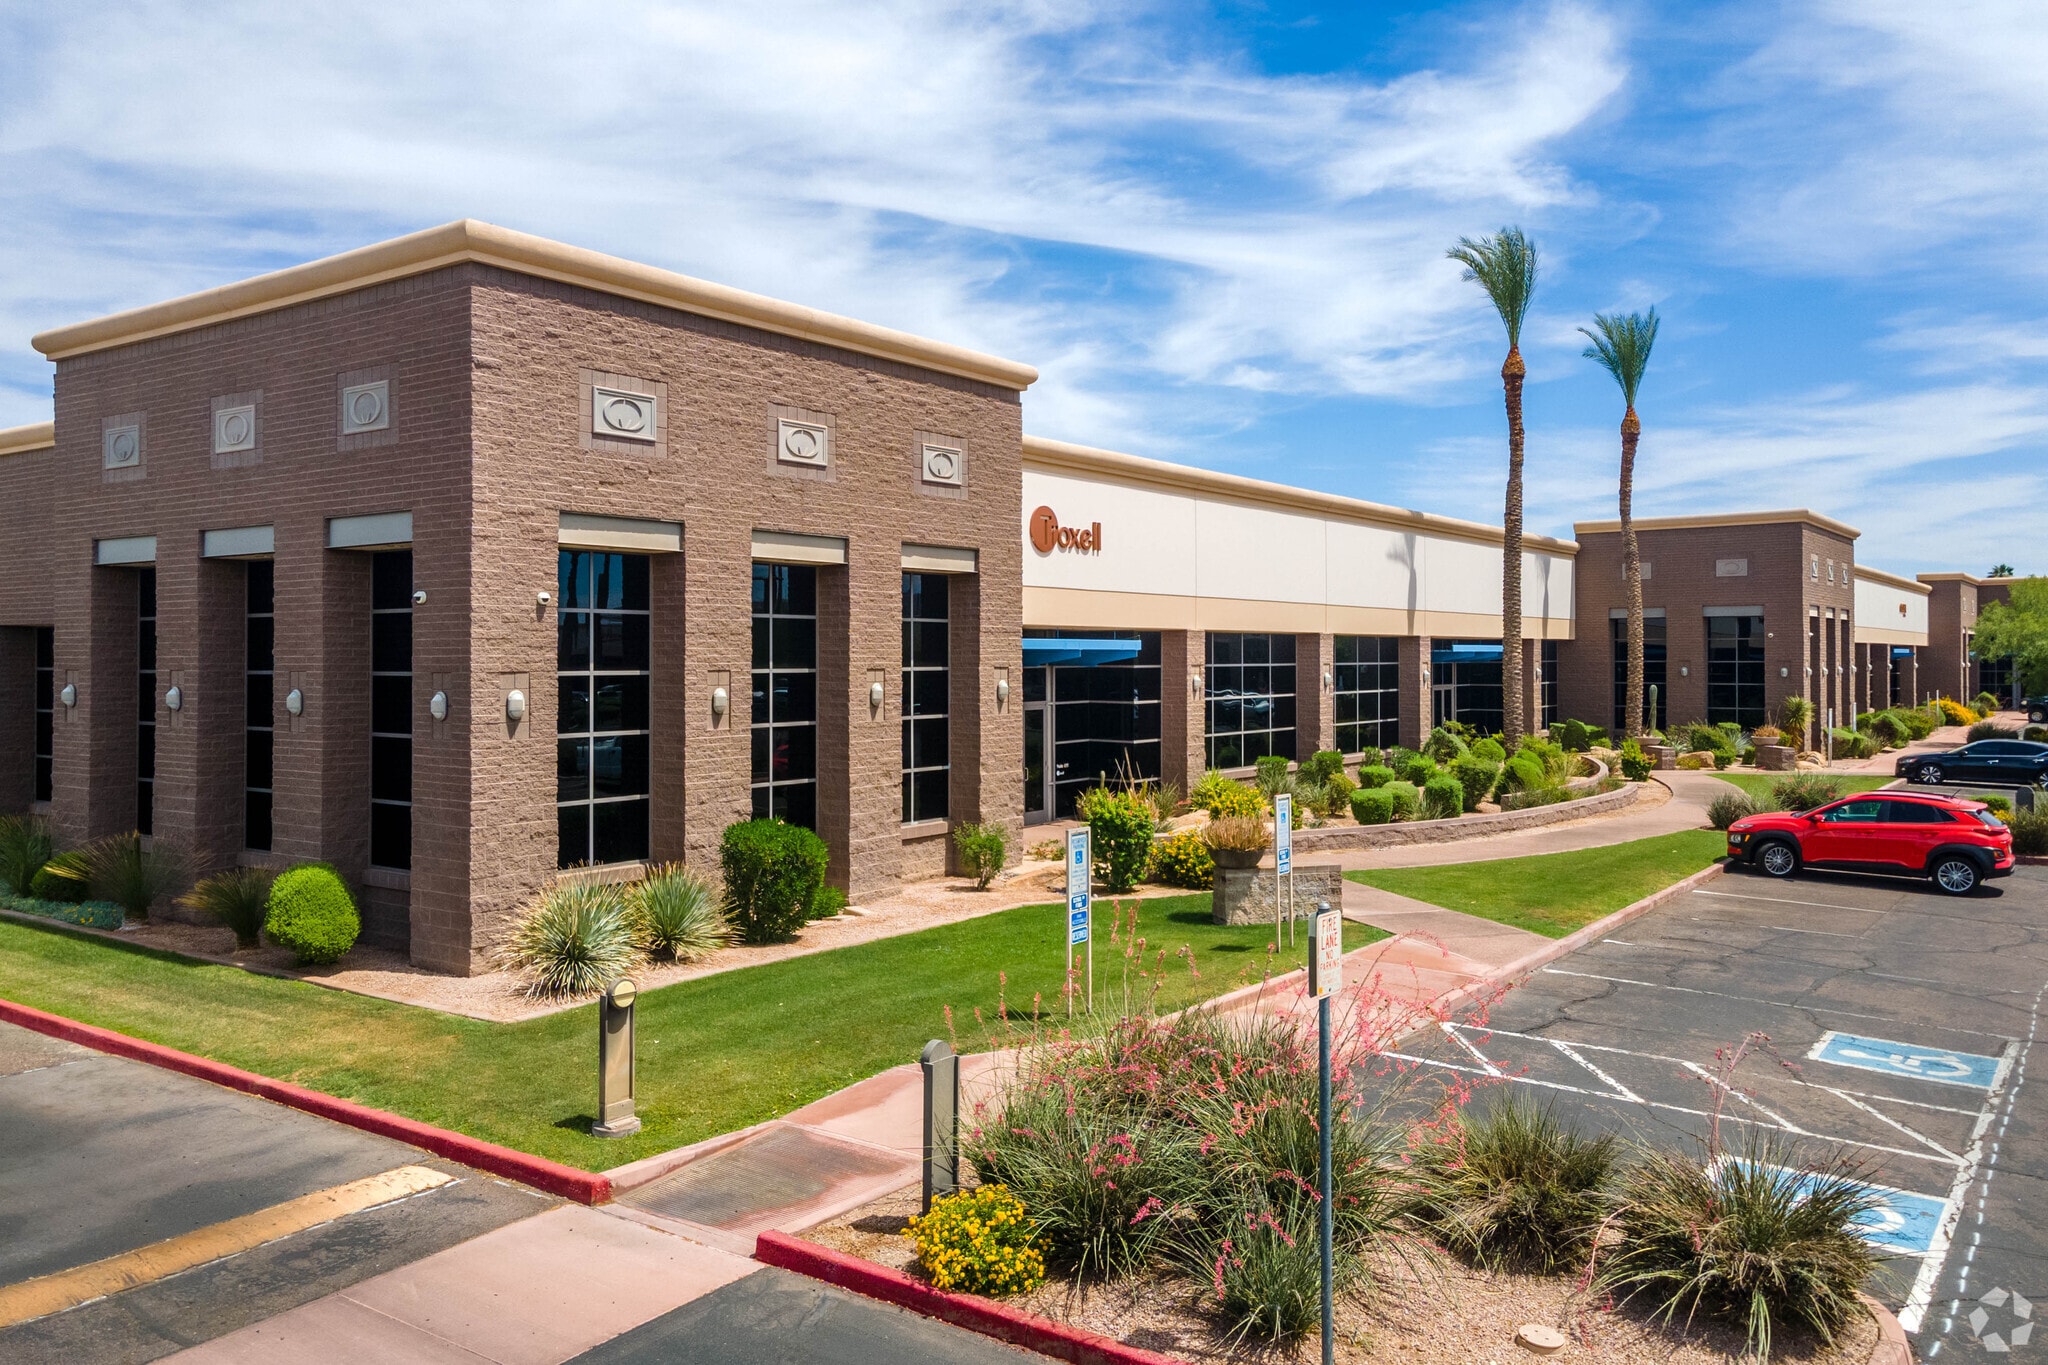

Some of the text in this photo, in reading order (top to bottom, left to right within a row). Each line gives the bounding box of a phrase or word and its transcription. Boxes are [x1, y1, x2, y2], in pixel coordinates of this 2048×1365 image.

[1322, 916, 1337, 934] FIRE
[1321, 932, 1337, 950] LANE
[1325, 949, 1334, 960] NO
